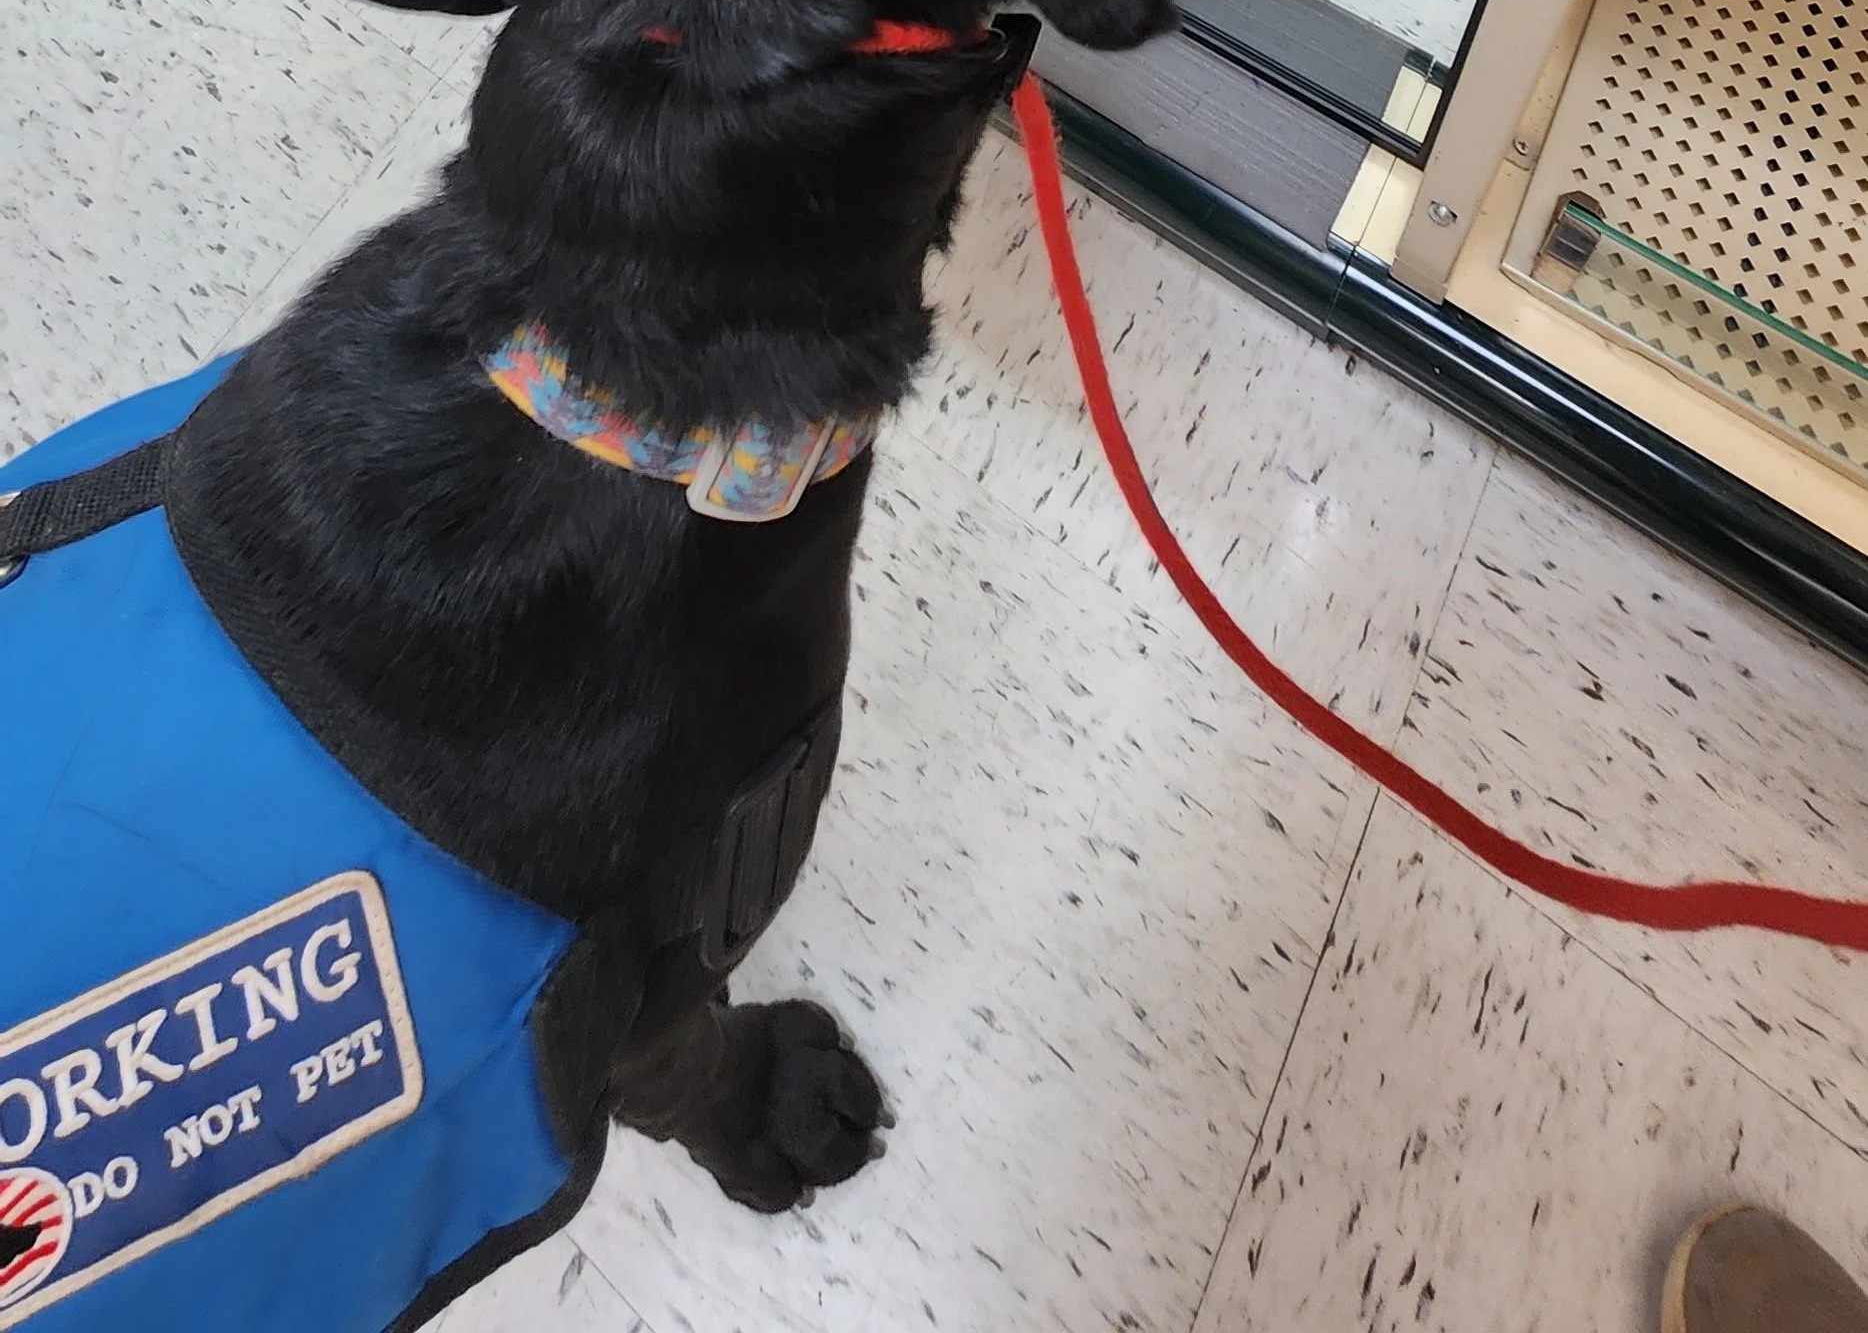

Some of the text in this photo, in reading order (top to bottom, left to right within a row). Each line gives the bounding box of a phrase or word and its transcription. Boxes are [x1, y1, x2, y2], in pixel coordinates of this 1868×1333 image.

[67, 1019, 383, 1219] DO NOT PET
